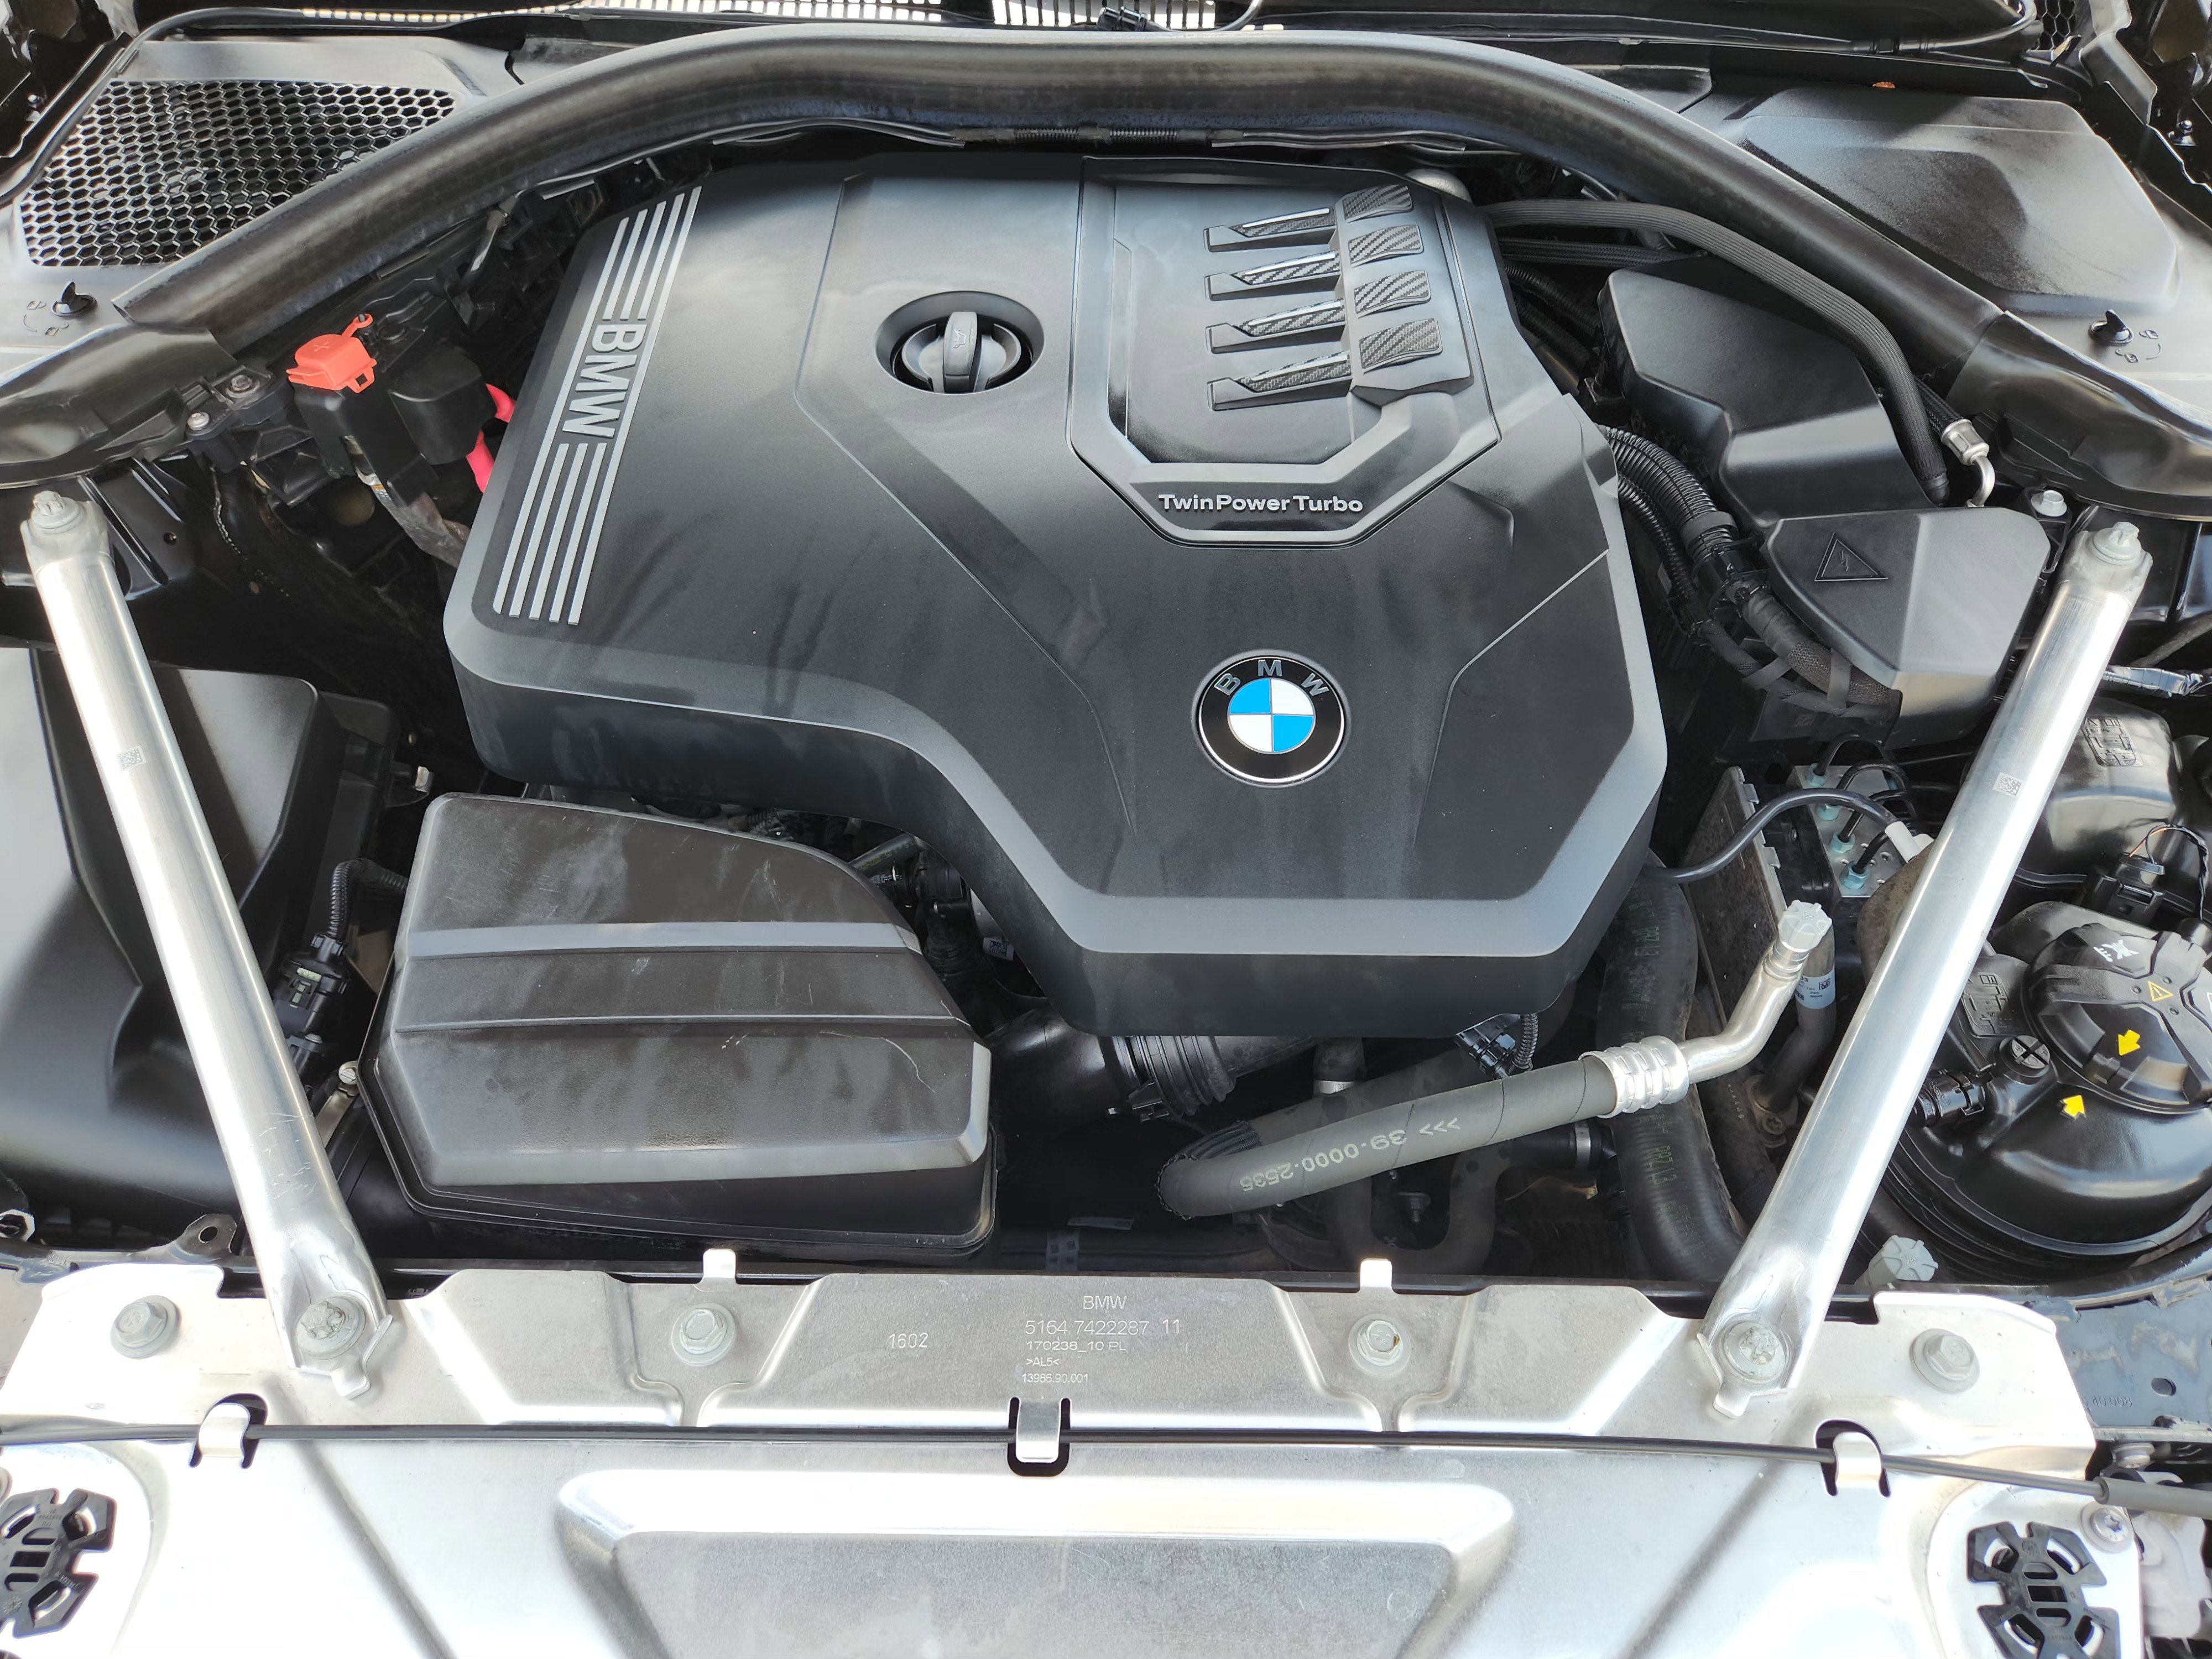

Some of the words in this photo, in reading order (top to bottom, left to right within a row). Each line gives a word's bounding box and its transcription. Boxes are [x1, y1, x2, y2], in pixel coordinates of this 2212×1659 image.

[562, 324, 648, 439] BMW
[1293, 495, 1364, 513] Turbo
[1213, 659, 1329, 697] BMW
[1083, 1296, 1127, 1310] BMW
[1025, 1320, 1068, 1335] 5164
[1074, 1320, 1150, 1335] 7422287
[1162, 1318, 1180, 1334] 11
[889, 1332, 928, 1349] 1602
[1108, 1341, 1126, 1351] PL
